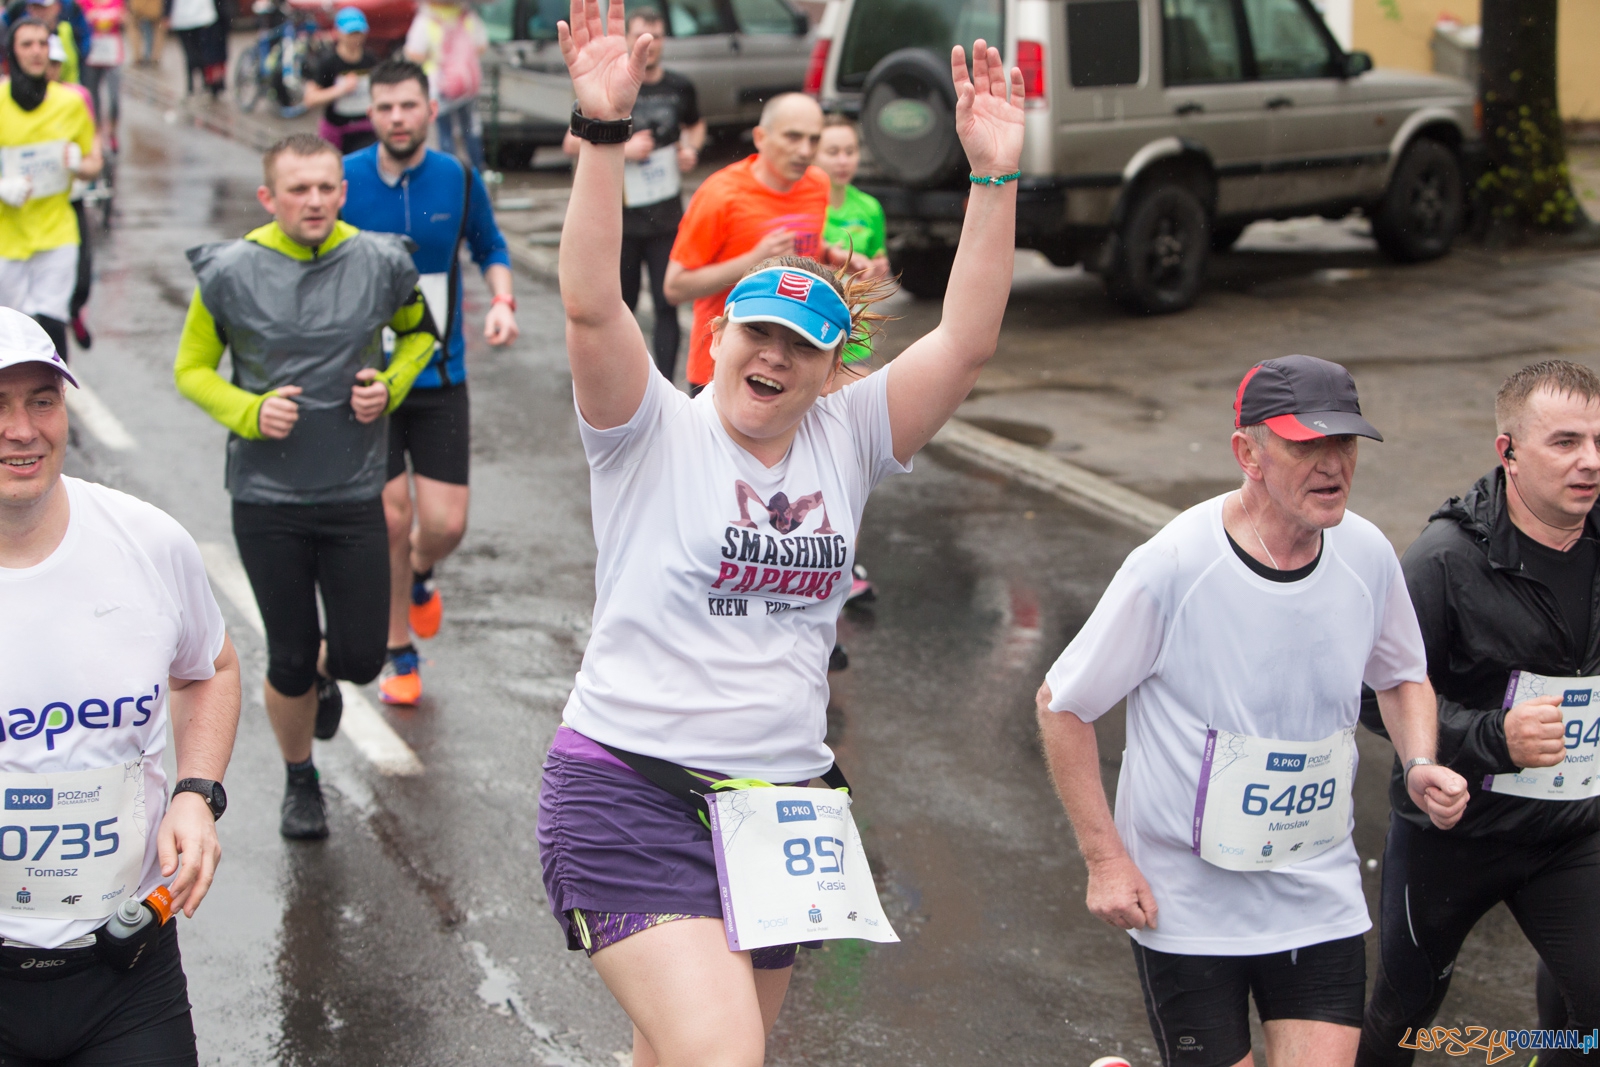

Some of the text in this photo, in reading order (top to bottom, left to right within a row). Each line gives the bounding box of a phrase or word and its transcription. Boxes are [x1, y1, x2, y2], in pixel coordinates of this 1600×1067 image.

[721, 527, 847, 569] SMASHING
[711, 561, 842, 600] PAPKINS
[708, 598, 748, 616] KREW
[0, 684, 159, 751] apers'
[1273, 757, 1301, 767] 9. PKO
[1564, 754, 1594, 763] Norbert
[12, 795, 46, 804] 9. PKO
[1241, 777, 1336, 816] 6489
[792, 805, 811, 815] PKO
[1268, 819, 1310, 831] Mirosław
[0, 816, 120, 862] 0735
[24, 867, 78, 877] Tomasz
[817, 880, 846, 891] Kasia
[36, 959, 66, 969] asics
